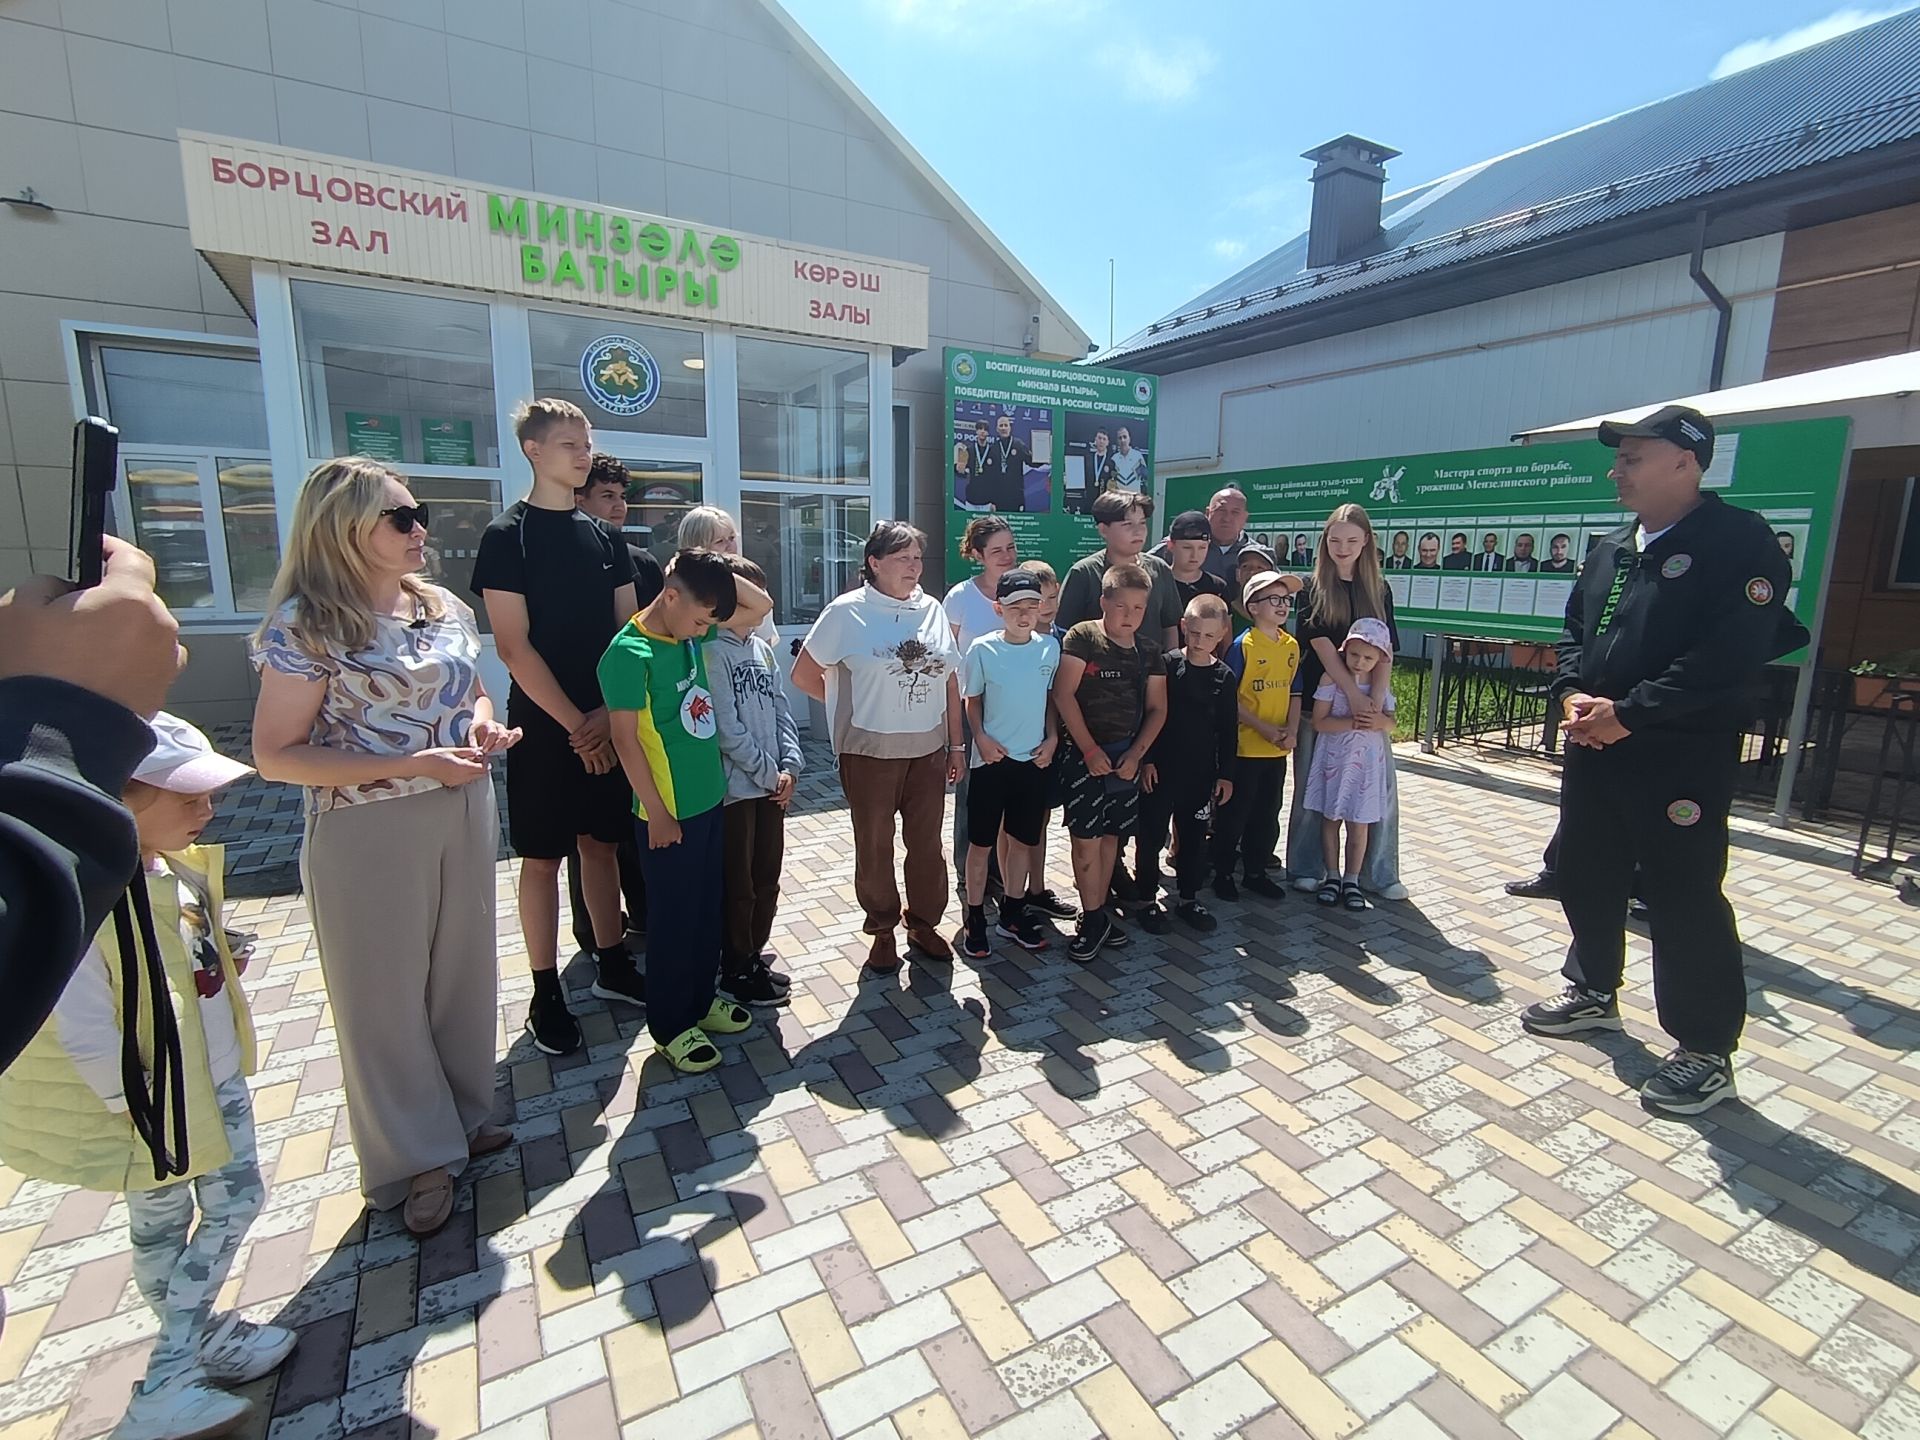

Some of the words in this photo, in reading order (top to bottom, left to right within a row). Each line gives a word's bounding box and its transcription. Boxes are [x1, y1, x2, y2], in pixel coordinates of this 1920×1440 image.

[211, 157, 468, 223] БОРЦОВСКИЙ
[310, 220, 390, 254] ЗАЛ
[520, 244, 719, 308] БАТЫРЫ
[794, 259, 880, 293] КӨРӘШ
[808, 299, 871, 325] ЗАЛЫ
[985, 361, 1050, 377] ВОСПИТАННИКИ
[1051, 369, 1106, 384] БОРЦОВСКОГО
[1106, 377, 1127, 387] ЗАЛА
[598, 396, 648, 413] ТАТАРСТАН
[954, 386, 1010, 400] ПОБЕДИТЕЛИ
[1011, 392, 1061, 406] ПЕРВЕНСТВА
[1062, 398, 1092, 409] РОССИИ
[1093, 402, 1118, 412] СРЕДИ
[1118, 405, 1150, 415] ЮНОШЕЙ
[1060, 384, 1100, 398] БАТЫРЫ»,
[1434, 468, 1475, 480] Мастера
[1476, 466, 1513, 477] спорта
[1515, 465, 1529, 473] по
[1530, 460, 1573, 473] борьбе,
[1415, 481, 1465, 495] уроженцы
[1466, 477, 1548, 491] Мензелинского
[1550, 474, 1593, 487] района
[1596, 555, 1633, 636] ТАТАРСТА
